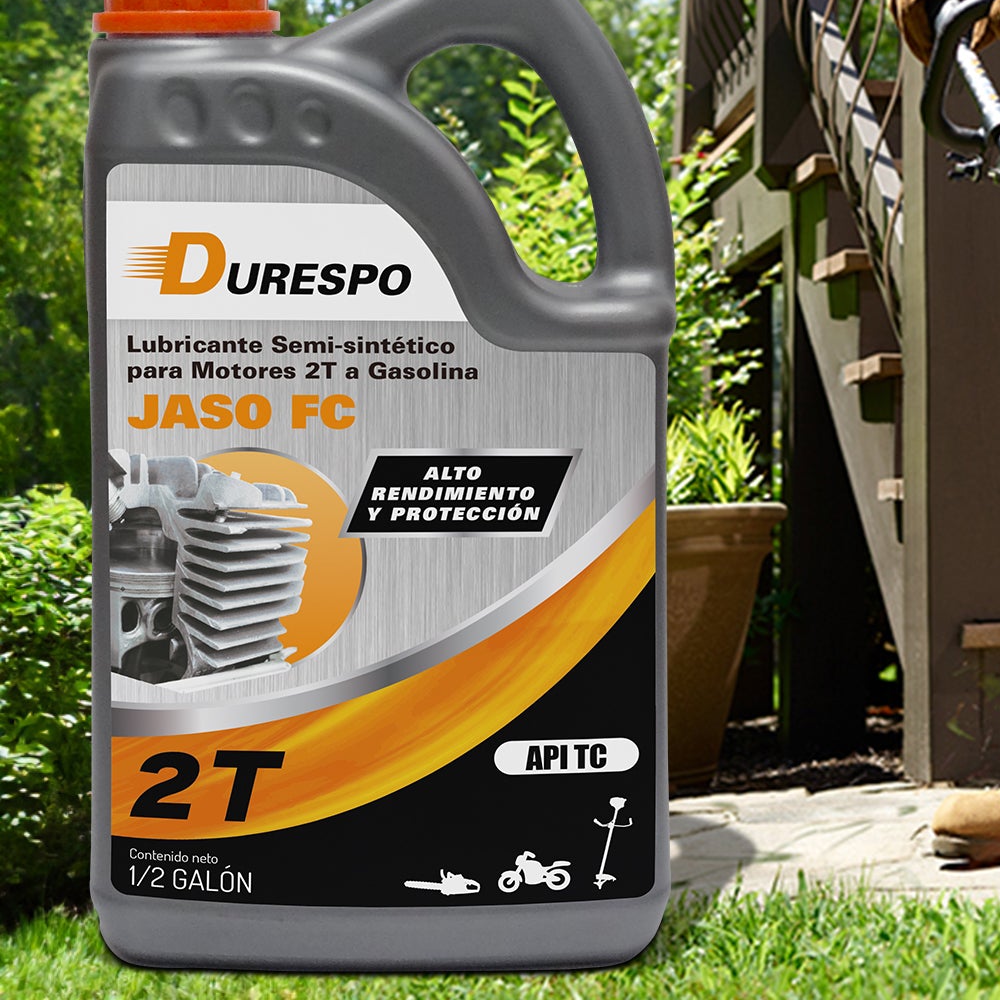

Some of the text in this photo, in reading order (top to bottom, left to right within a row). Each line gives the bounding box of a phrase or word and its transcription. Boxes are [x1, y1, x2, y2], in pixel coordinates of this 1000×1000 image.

[159, 231, 412, 296] DURESPO
[126, 335, 456, 355] Lubricante Semi-sintético
[126, 361, 479, 384] para Motores 2T a Gasolina
[127, 393, 356, 431] JASO FC
[422, 465, 483, 482] ALTO
[370, 486, 536, 502] RENDIMIENTO
[367, 502, 541, 523] Y PROTECCIÓN
[525, 743, 608, 771] API TC
[129, 749, 286, 823] 2T
[128, 847, 219, 865] Contenido neto
[128, 863, 253, 894] 1/2 GALÓN
